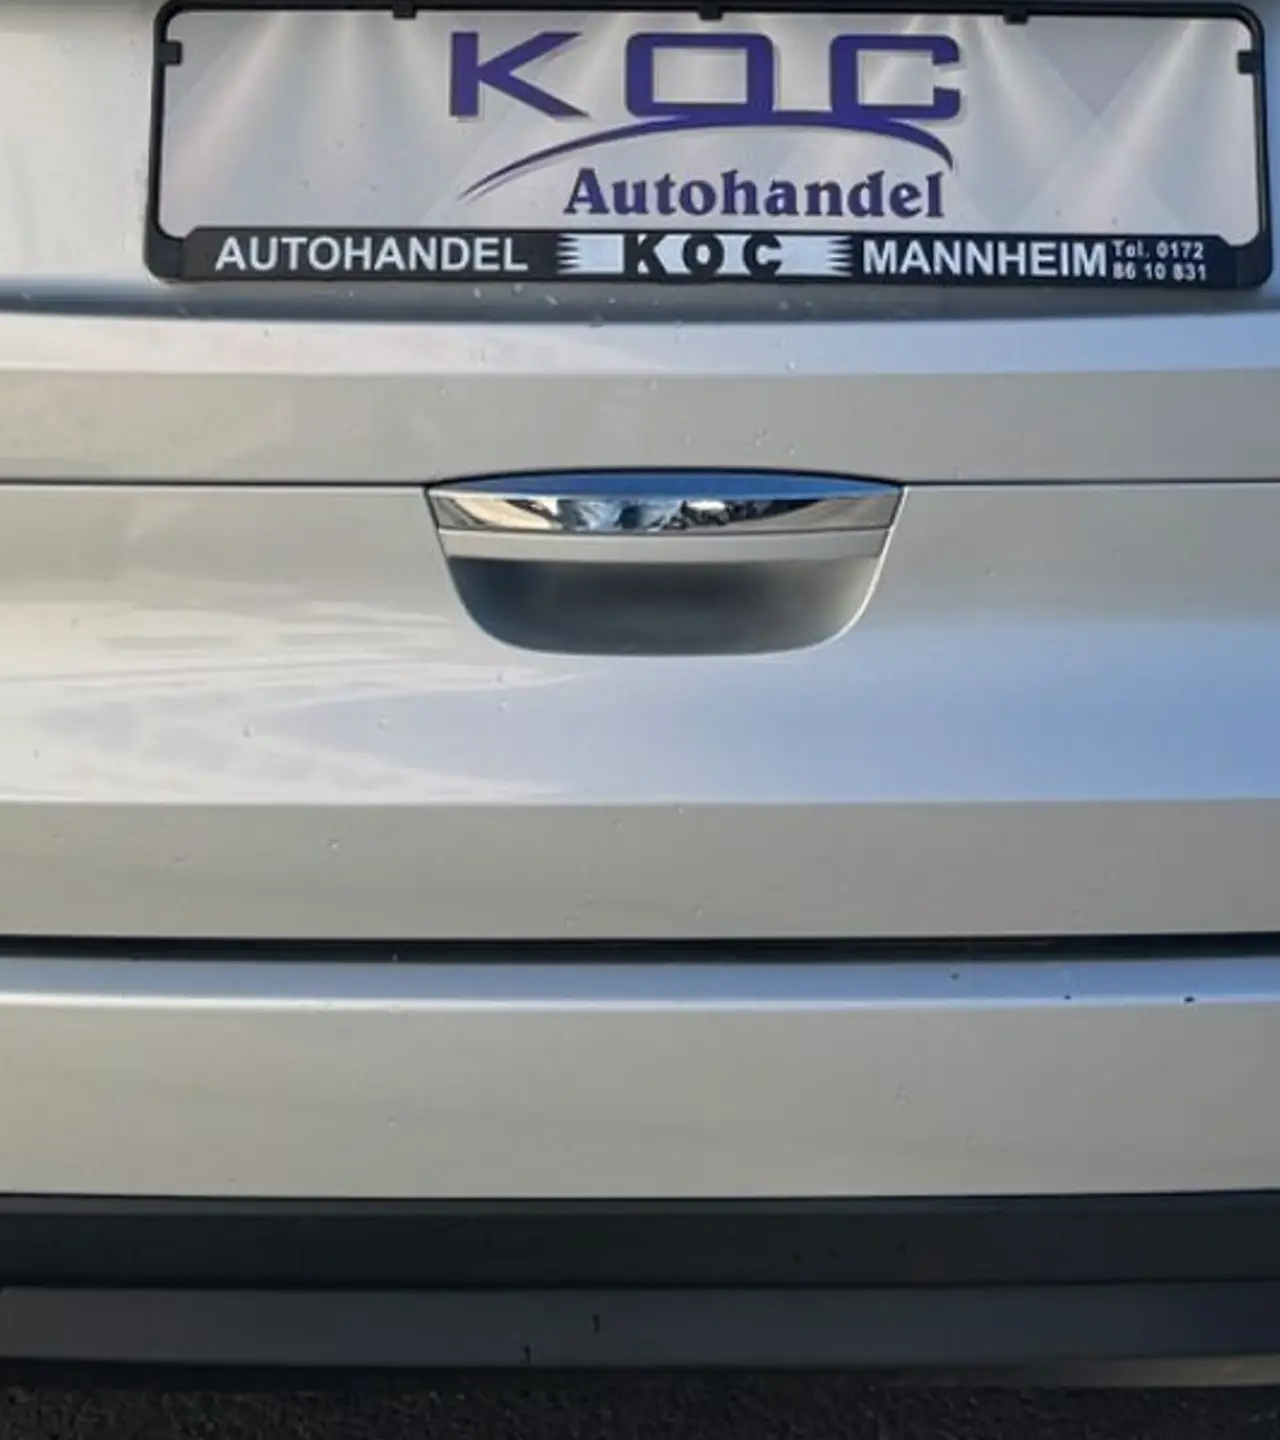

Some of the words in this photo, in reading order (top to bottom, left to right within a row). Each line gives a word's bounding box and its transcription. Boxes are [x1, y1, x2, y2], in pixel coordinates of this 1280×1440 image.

[449, 31, 962, 120] KOC
[563, 167, 944, 219] Autohandel
[215, 235, 528, 272] AUTOHANDEL
[863, 240, 1108, 278] MANNHEIM
[1112, 239, 1150, 259] Tel.
[1156, 241, 1204, 260] 0172
[1144, 262, 1167, 280] 10
